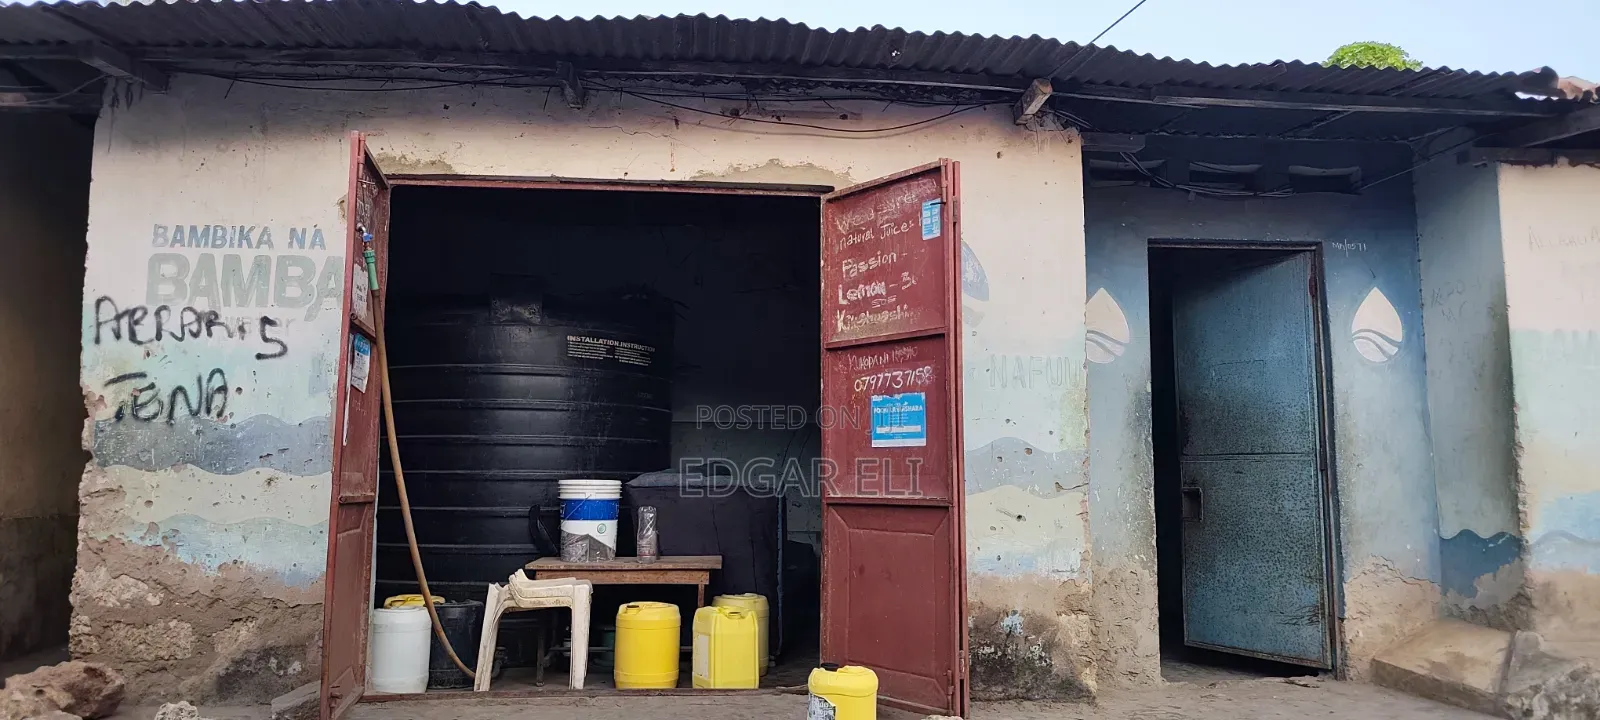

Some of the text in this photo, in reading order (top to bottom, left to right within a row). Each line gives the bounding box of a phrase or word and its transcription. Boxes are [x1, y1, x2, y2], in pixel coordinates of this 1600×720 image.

[152, 223, 274, 250] BAMBIKA
[839, 228, 875, 251] natural
[842, 250, 897, 279] Passion
[145, 252, 344, 322] BAMBA
[838, 280, 887, 305] Lemon
[567, 335, 619, 346] INSTALLATION
